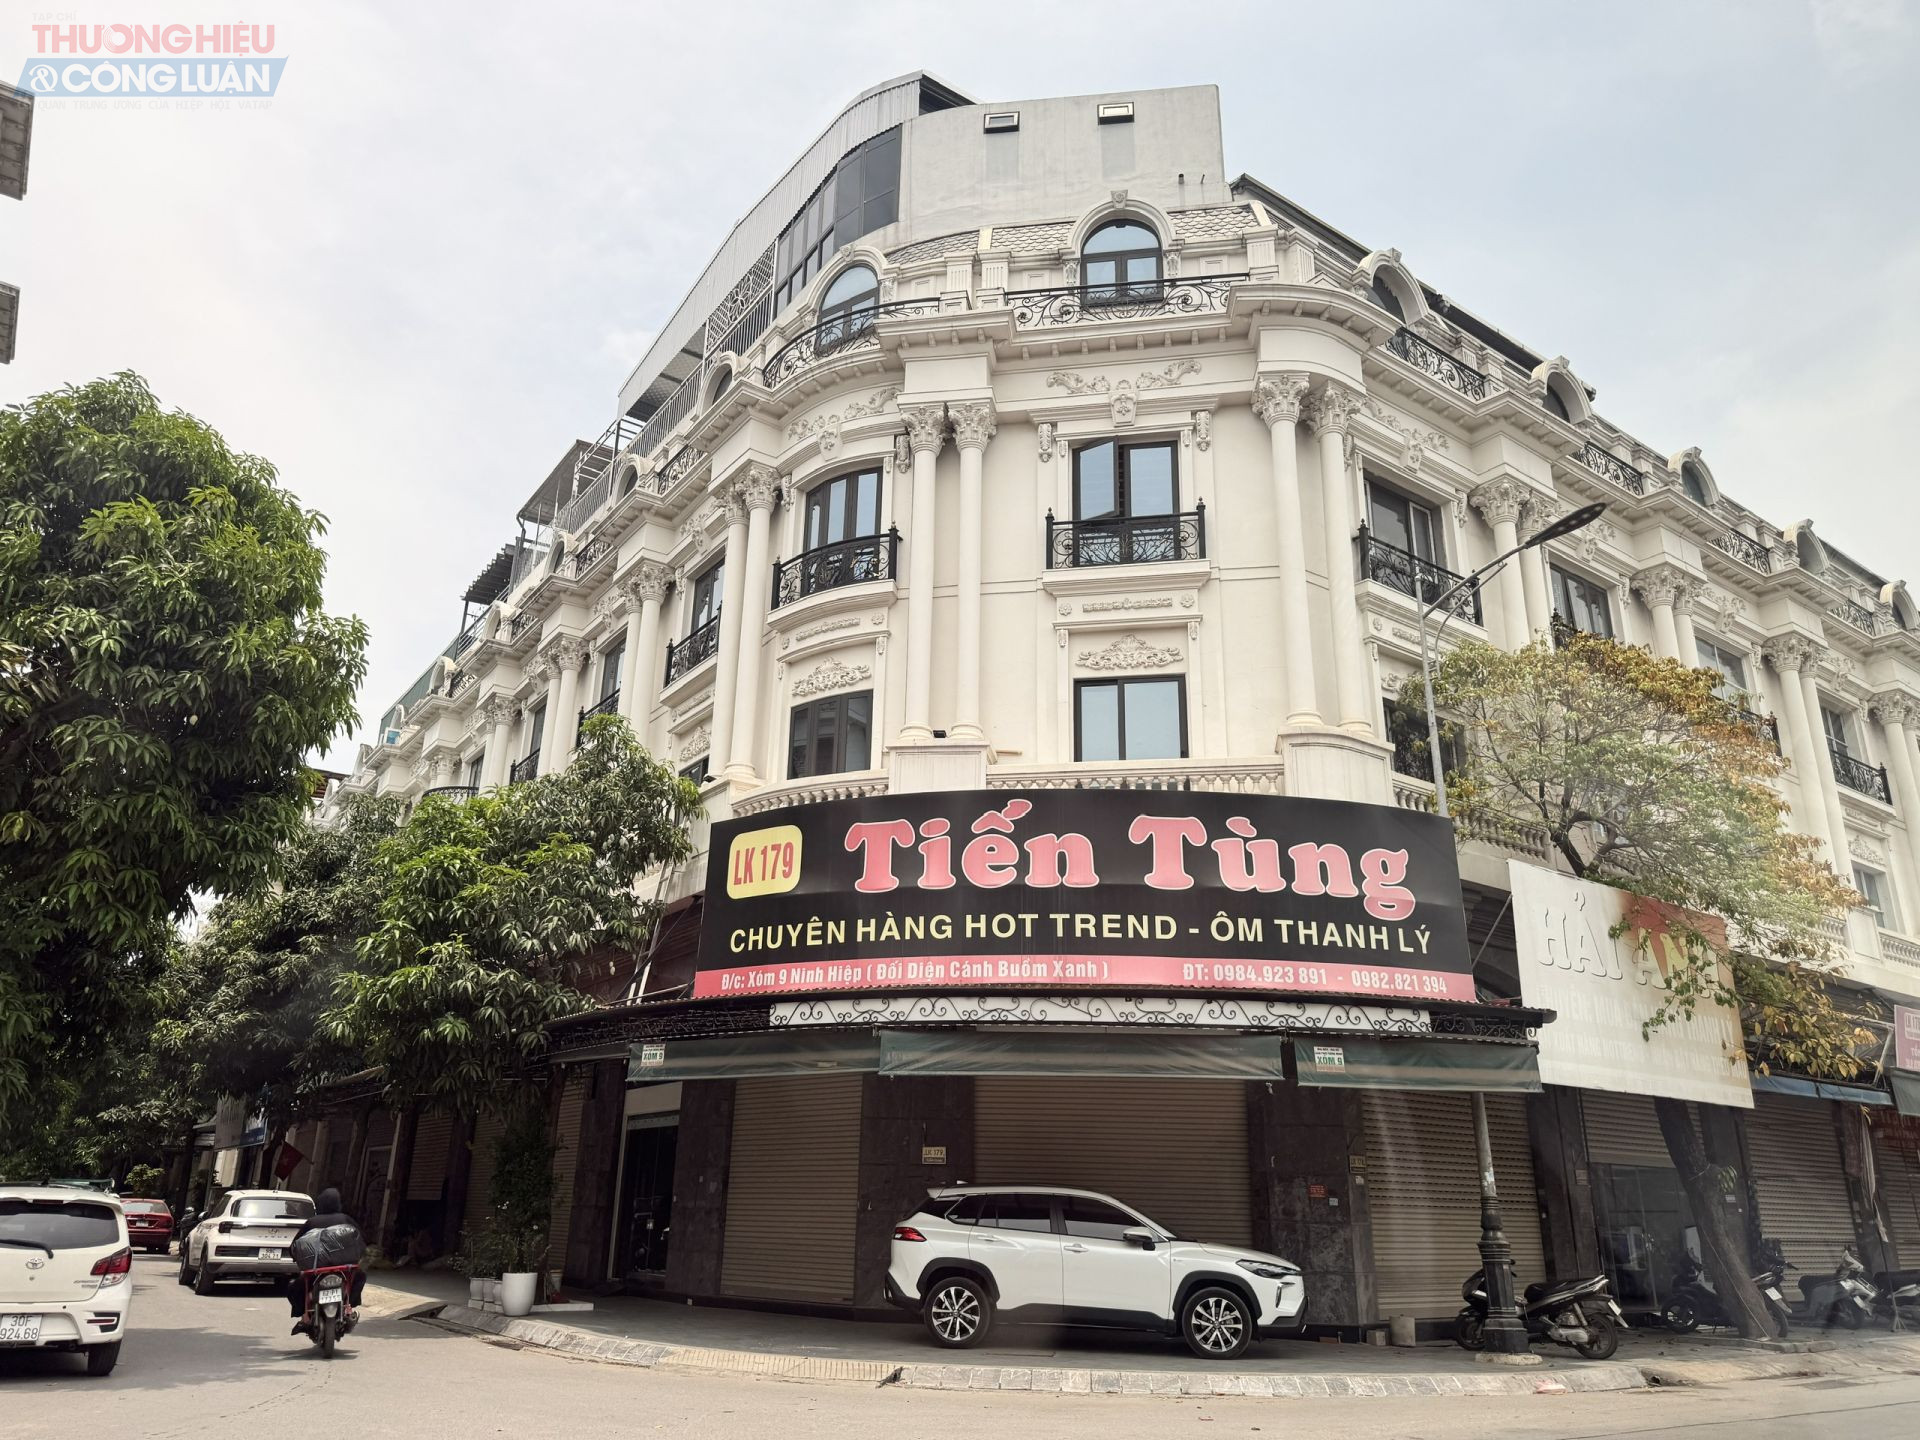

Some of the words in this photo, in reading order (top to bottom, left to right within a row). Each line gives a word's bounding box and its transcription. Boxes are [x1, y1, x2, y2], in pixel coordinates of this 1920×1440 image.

[733, 847, 756, 886] LK
[760, 841, 794, 881] 179
[843, 798, 1099, 893] Tiến
[1128, 813, 1416, 921] Tùng
[730, 916, 845, 953] CHUYÊN
[856, 911, 952, 943] HÀNG
[965, 912, 1039, 939] HOT
[1050, 912, 1177, 940] TREND
[1210, 910, 1263, 943] ÔM
[1274, 918, 1390, 951] THANH
[1399, 923, 1431, 955] LÝ
[721, 972, 745, 990] Đ/c:
[748, 969, 775, 988] Xóm
[778, 968, 786, 984] 9
[790, 966, 823, 984] Ninh
[828, 965, 862, 985] Hiệp
[877, 960, 903, 980] Đối
[907, 960, 945, 981] Diện
[950, 960, 993, 978] Cánh
[1053, 960, 1097, 978] Xanh
[1182, 962, 1209, 981] ĐT:
[1213, 964, 1294, 984] 0984.923
[1299, 968, 1328, 985] 891
[1351, 970, 1419, 992] 0982.821
[1423, 975, 1448, 994] 394
[0, 1328, 39, 1340] 924.68
[10, 1315, 33, 1327] 30F
